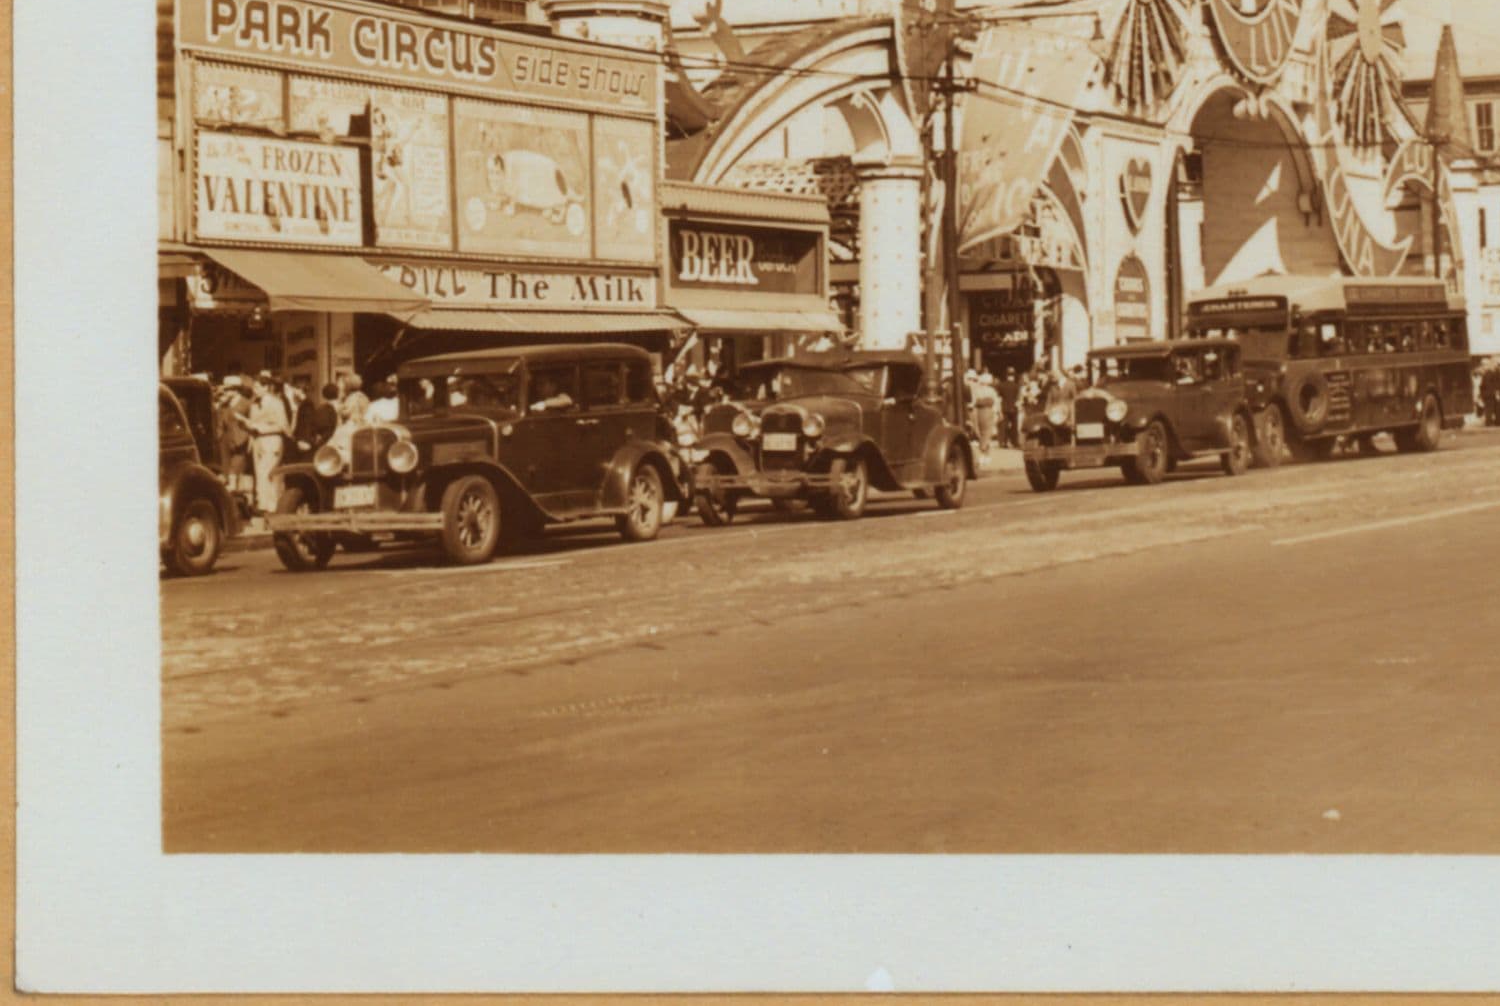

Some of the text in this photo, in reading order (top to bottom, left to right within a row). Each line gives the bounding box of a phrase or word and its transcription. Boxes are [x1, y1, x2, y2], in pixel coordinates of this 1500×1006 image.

[352, 19, 497, 80] CIRCUS
[262, 145, 344, 176] FROZEN
[203, 176, 355, 223] VALENTINE
[679, 230, 759, 285] BEER
[382, 264, 645, 302] PILL The Milk
